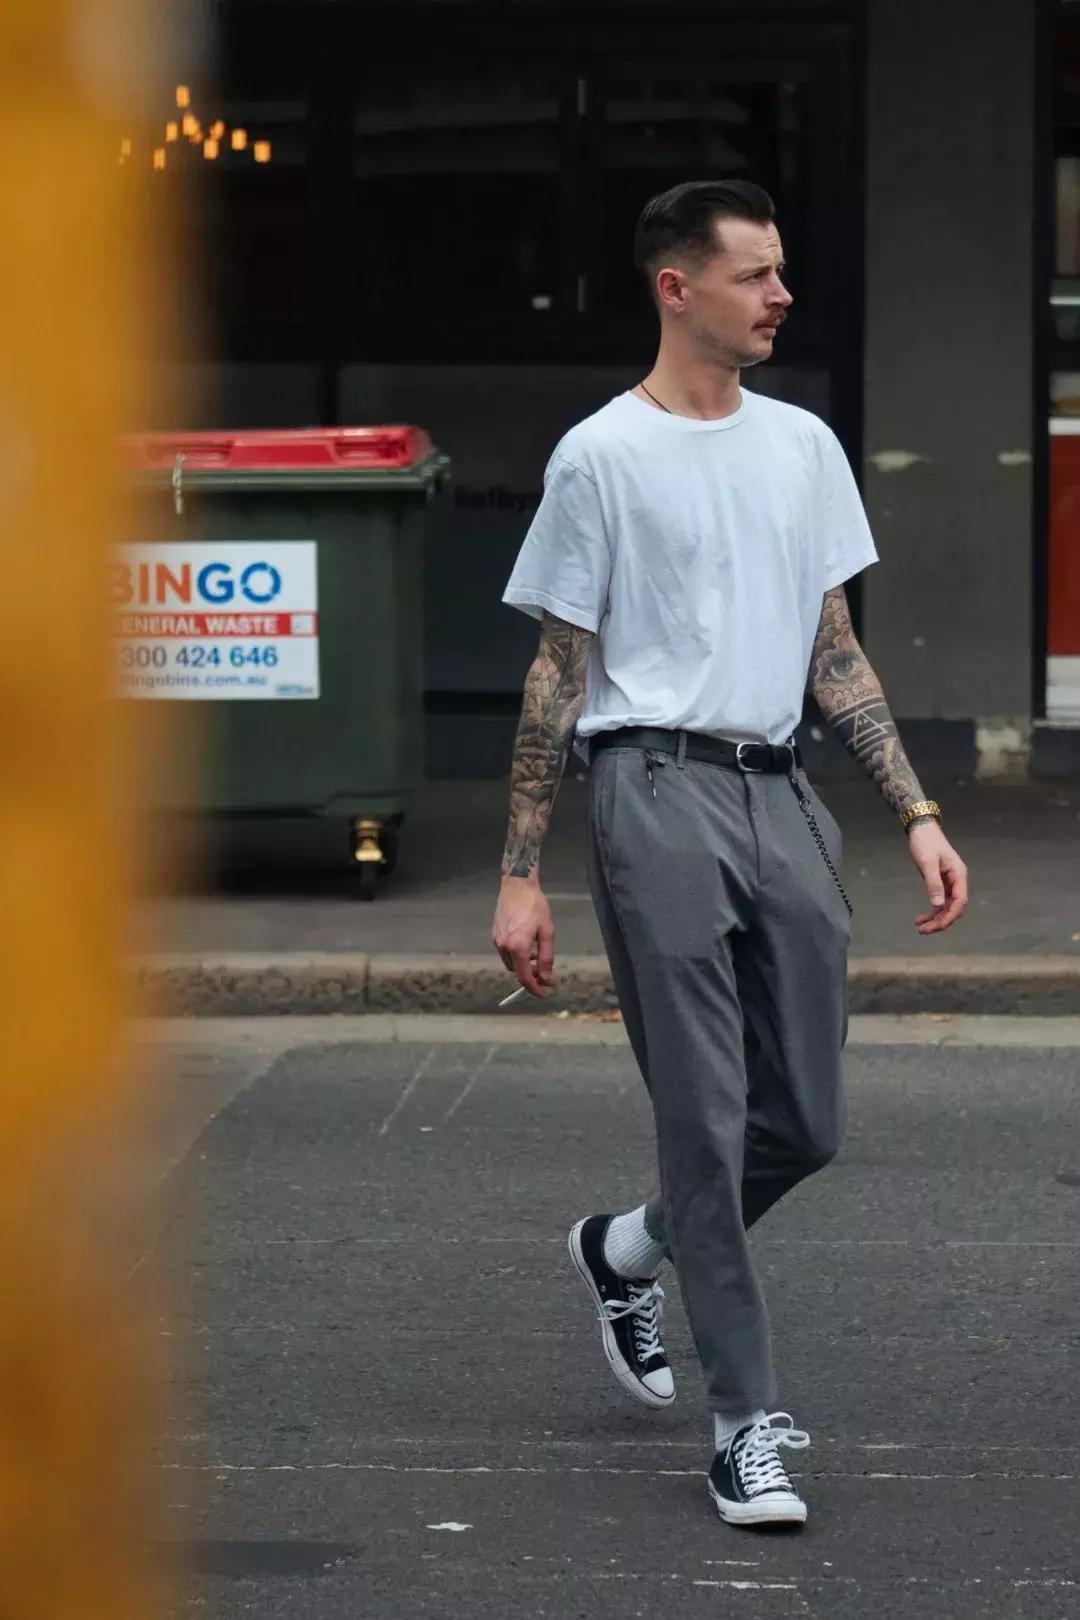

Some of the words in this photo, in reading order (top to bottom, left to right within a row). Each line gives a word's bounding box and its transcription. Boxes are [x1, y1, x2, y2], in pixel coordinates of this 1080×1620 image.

[108, 562, 281, 604] BINGO
[121, 615, 200, 634] ENERAL
[205, 615, 278, 634] WASTE
[120, 645, 167, 668] 300
[175, 645, 221, 668] 424
[229, 645, 279, 668] 646
